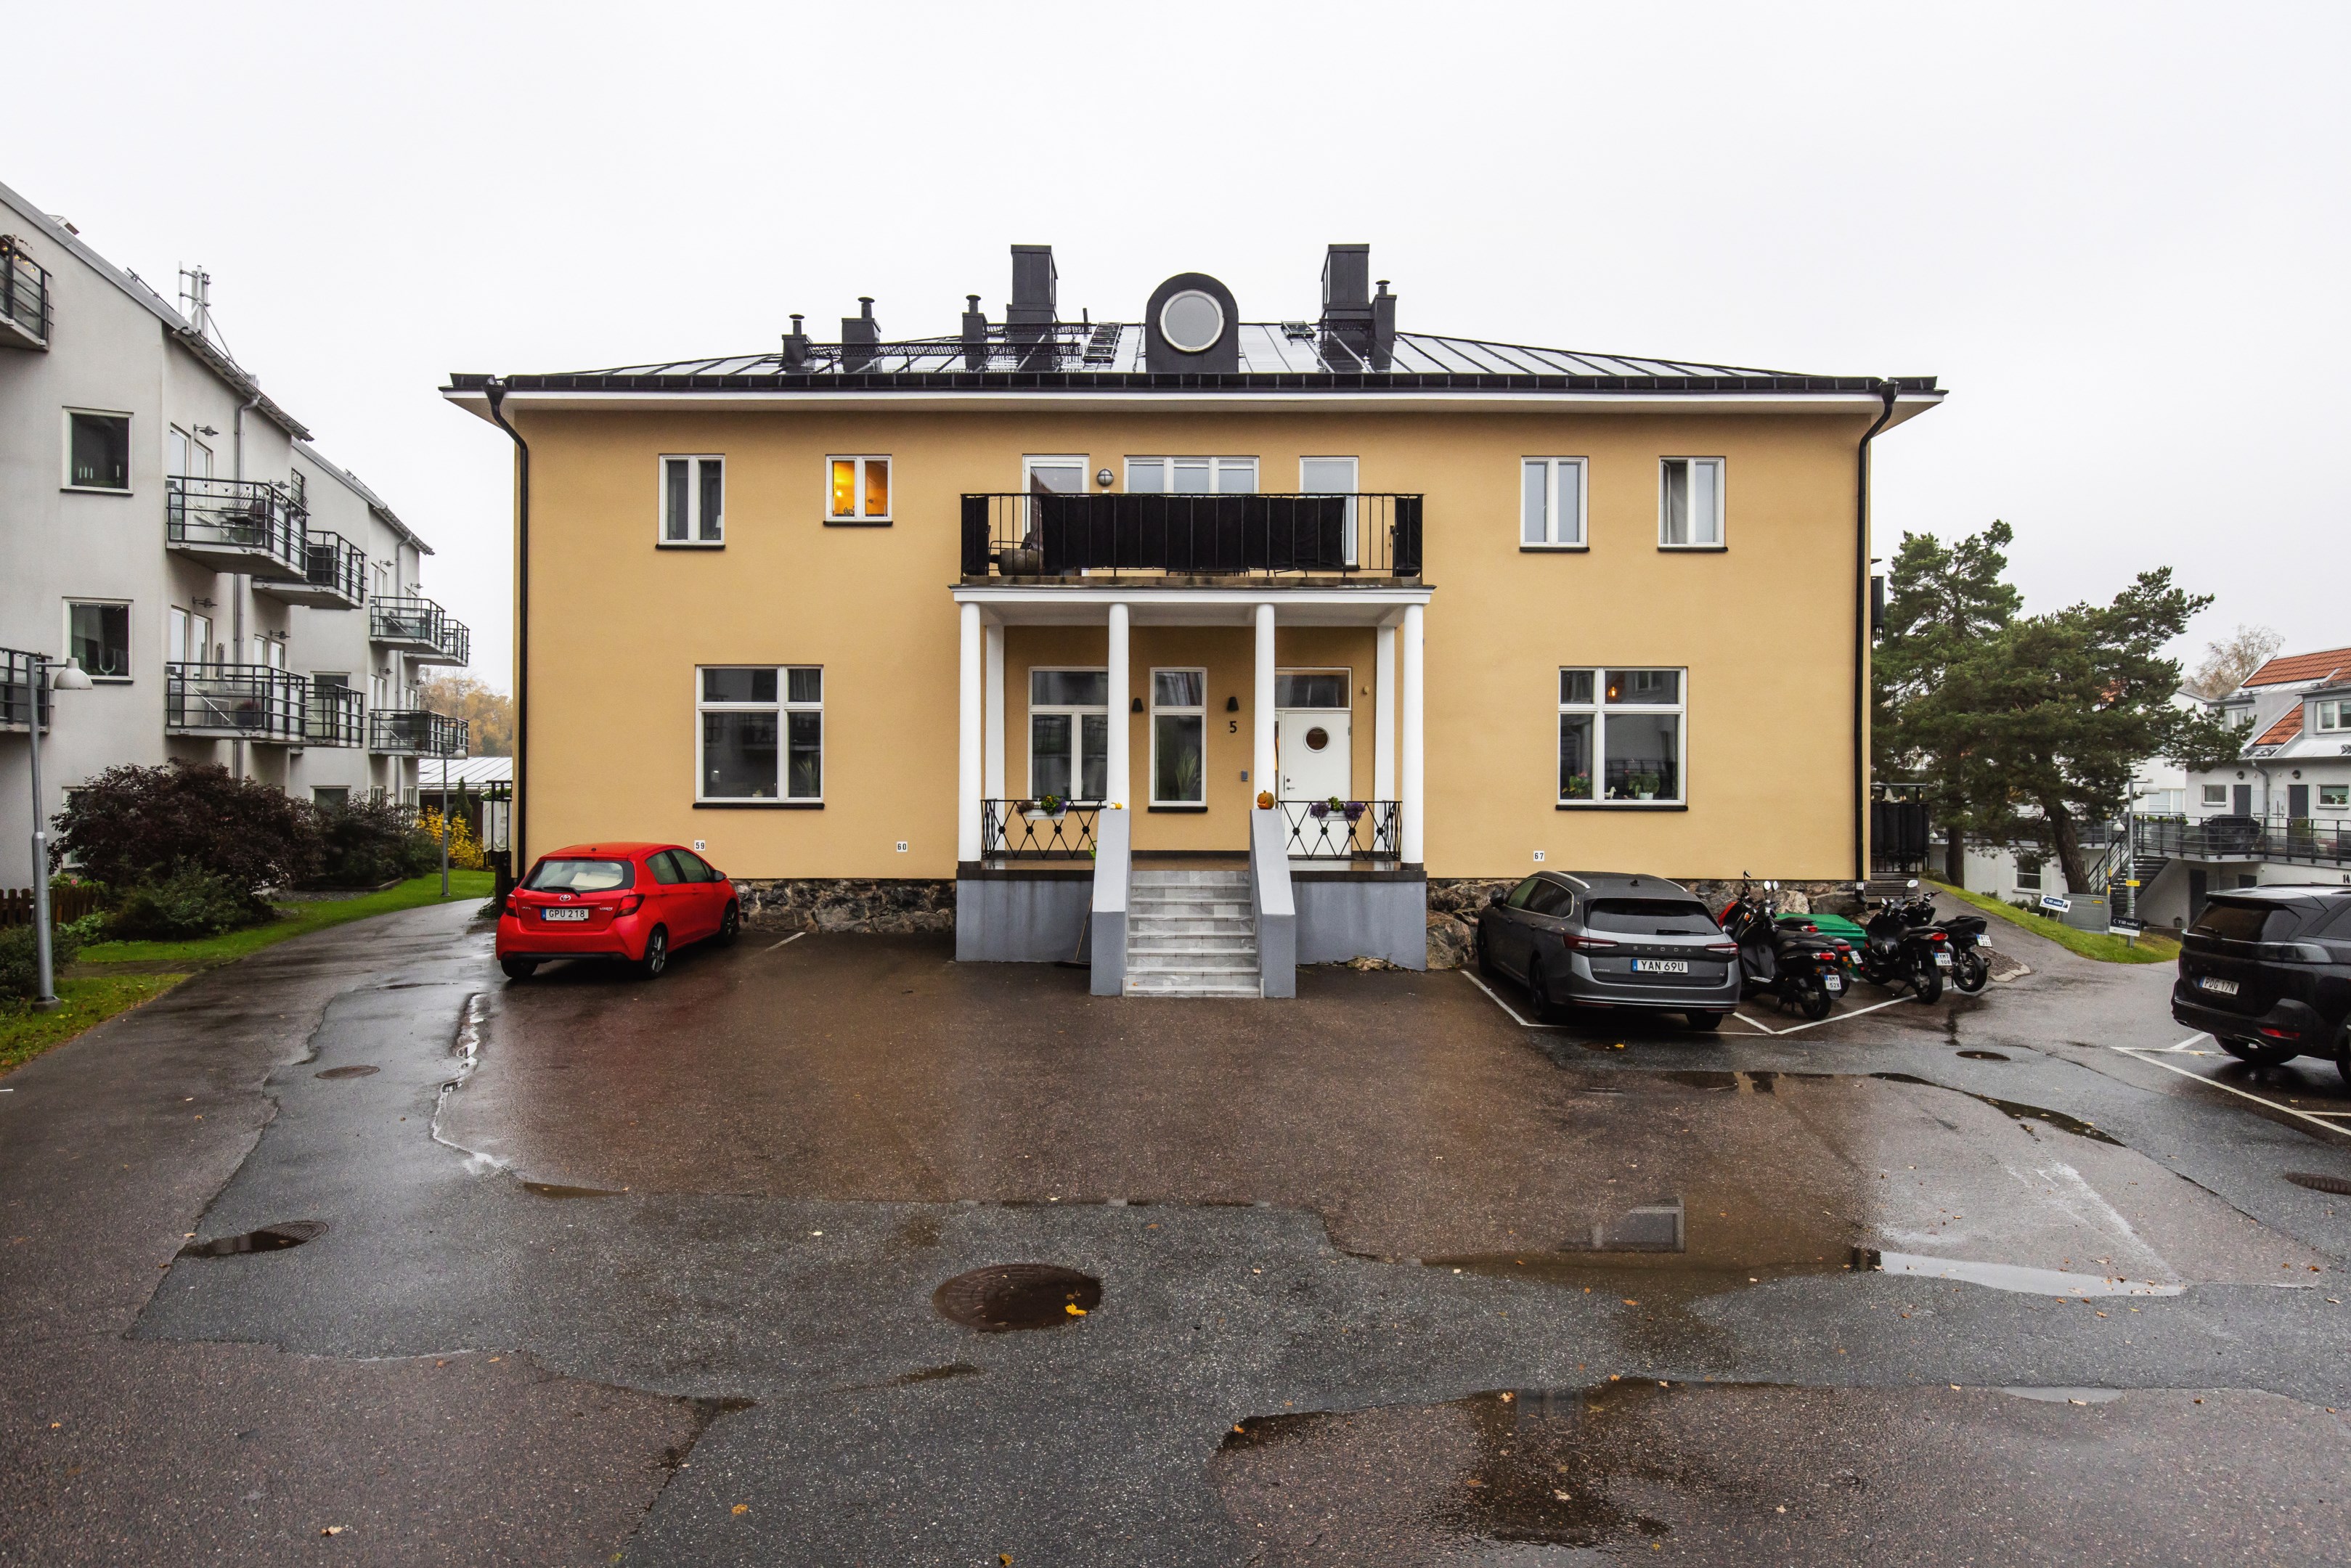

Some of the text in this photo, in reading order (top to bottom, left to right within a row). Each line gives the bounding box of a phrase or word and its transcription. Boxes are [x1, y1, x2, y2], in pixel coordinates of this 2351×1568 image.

[1229, 720, 1237, 733] 5
[2342, 873, 2350, 883] 14
[1641, 960, 1684, 971] YAN 69U
[2205, 978, 2236, 993] PDG 17N
